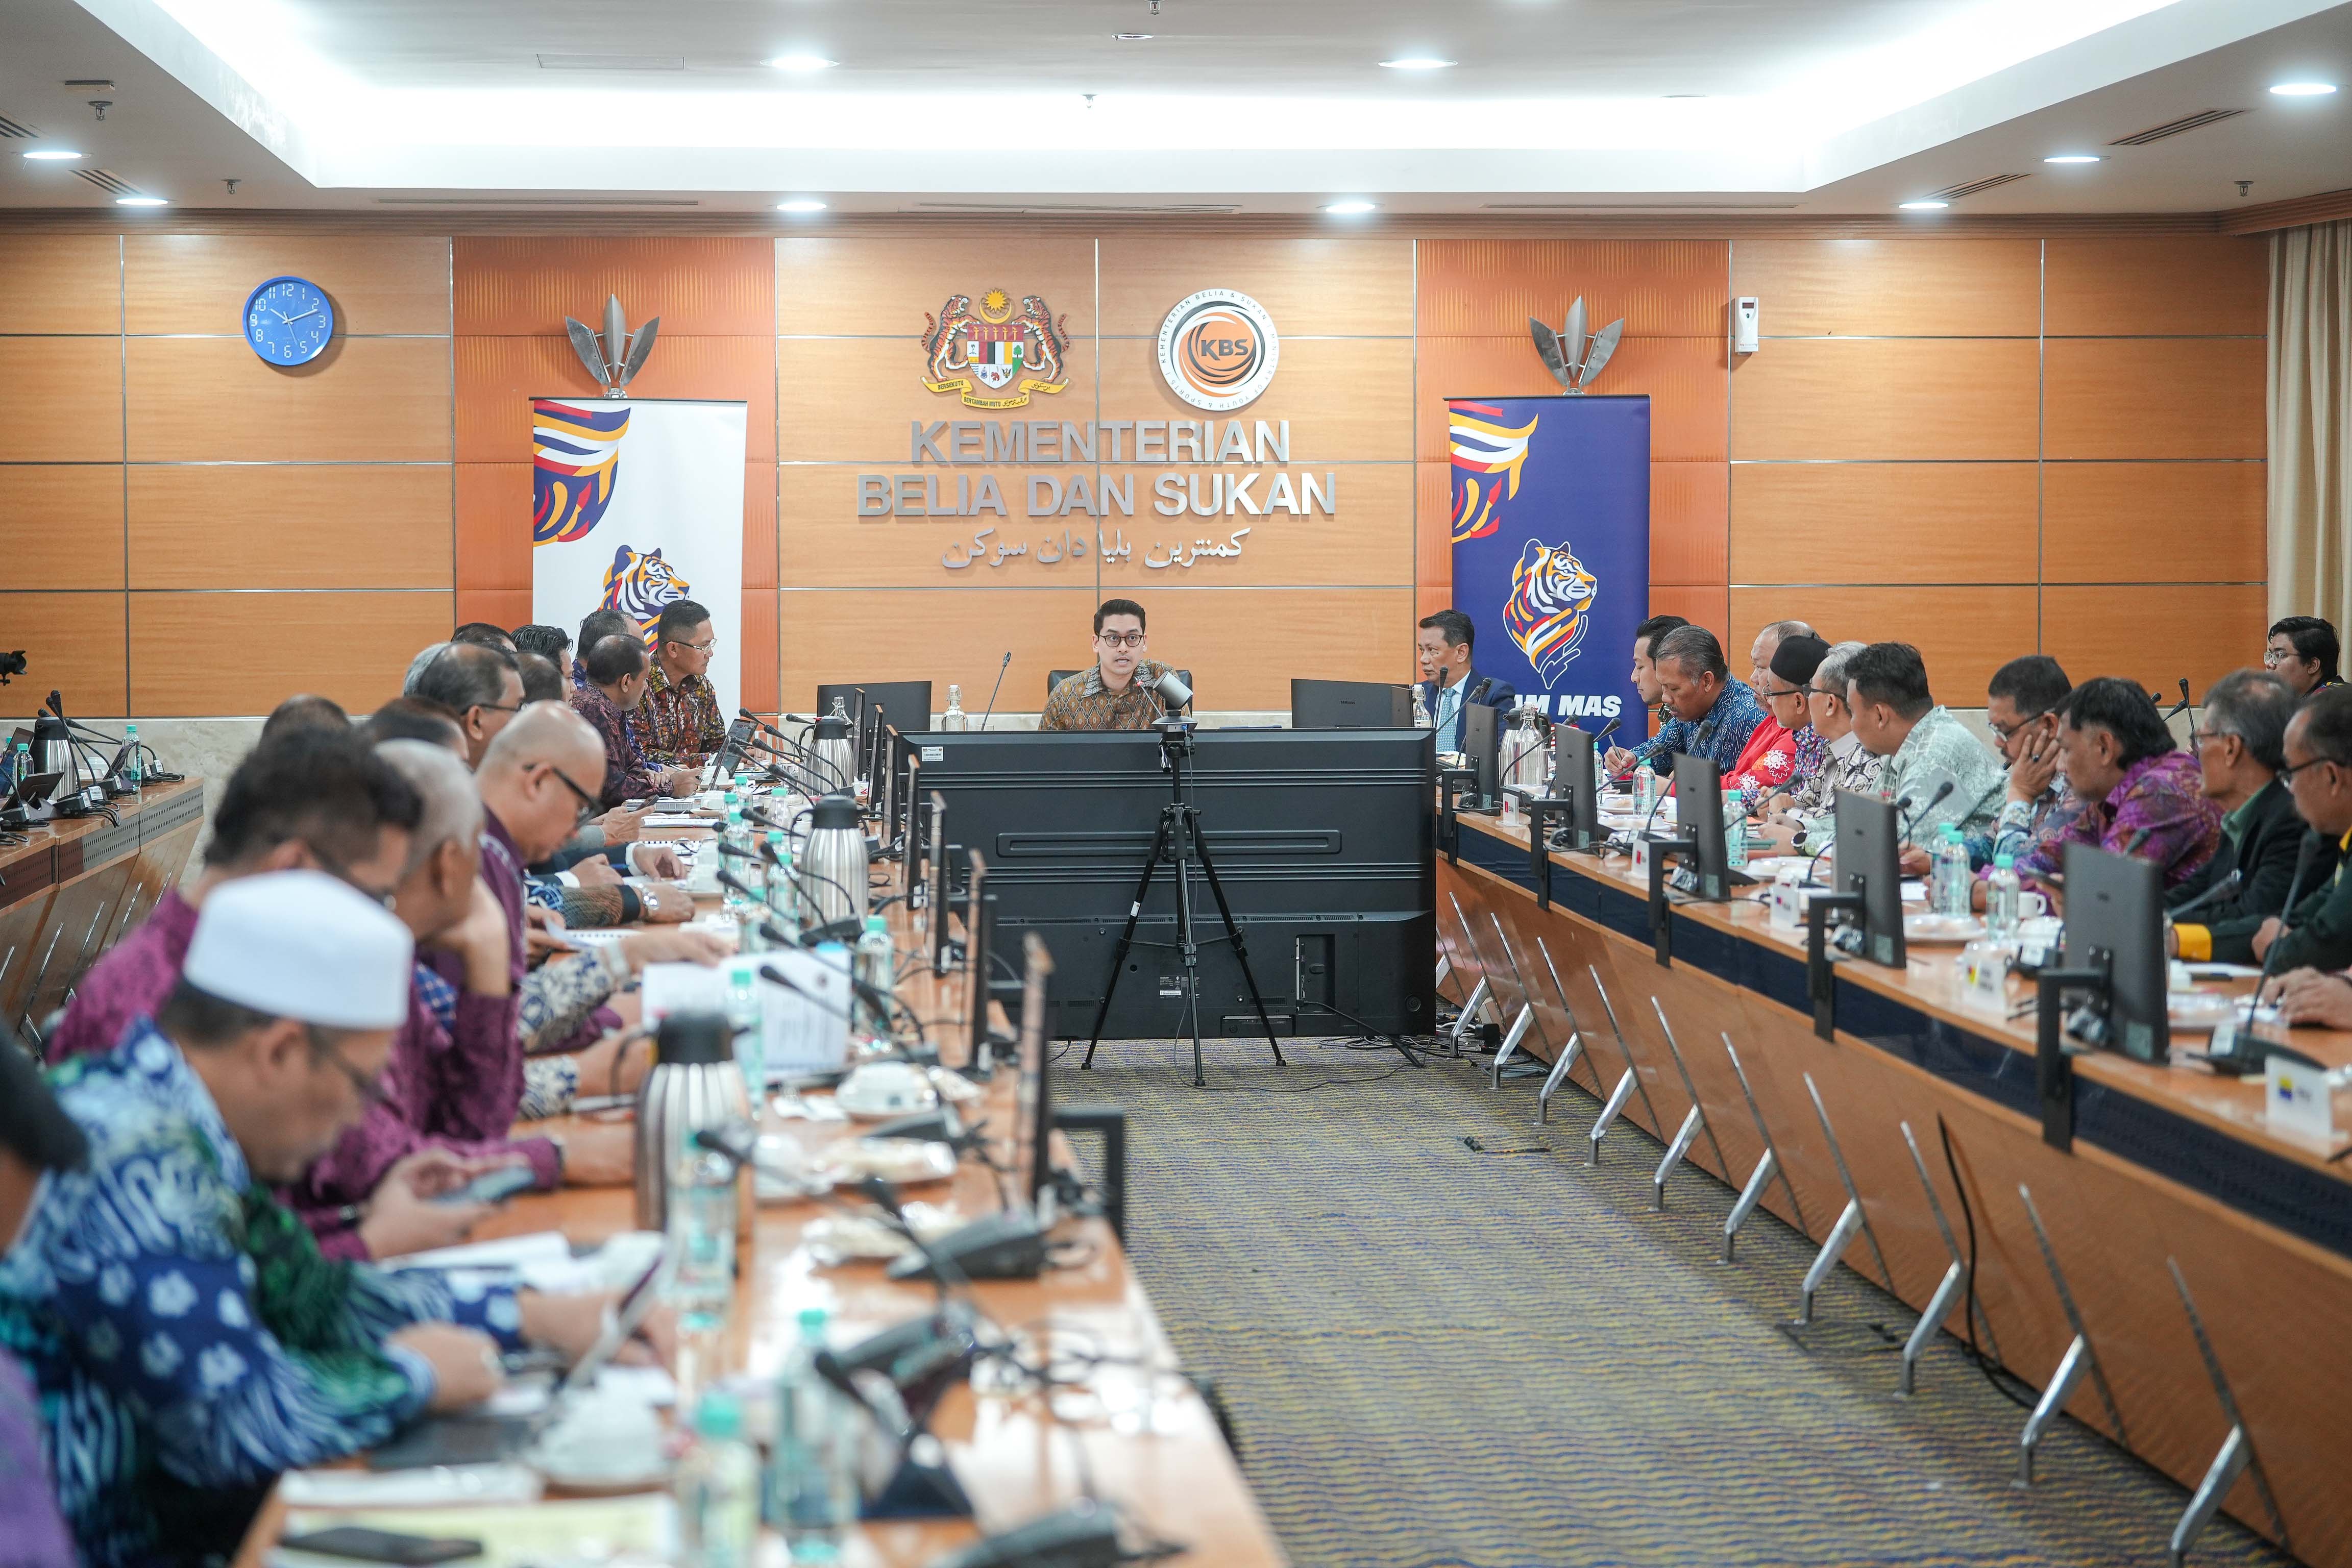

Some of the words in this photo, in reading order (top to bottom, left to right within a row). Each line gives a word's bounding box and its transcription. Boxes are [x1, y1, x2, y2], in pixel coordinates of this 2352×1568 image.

[269, 286, 276, 299] 11
[282, 284, 294, 297] 12
[302, 287, 305, 300] 1
[255, 298, 266, 311] 10
[312, 298, 320, 310] 2
[250, 313, 258, 327] 9
[318, 314, 326, 328] 3
[1160, 300, 1190, 363] KEMENTERIAN
[1195, 290, 1224, 300] BELIA
[1241, 296, 1267, 321] SUKAN
[255, 329, 263, 342] 8
[311, 331, 319, 344] 4
[267, 341, 275, 354] 7
[284, 345, 292, 358] 6
[300, 340, 307, 354] 5
[1200, 339, 1248, 360] KBS
[938, 380, 964, 390] BERSEKUTU
[1170, 379, 1202, 406] SPORTS
[963, 397, 988, 407] BERTAMBAH
[1219, 396, 1250, 409] YOUTH
[911, 420, 1290, 462] KEMENTERIAN
[857, 474, 1007, 516] BELIA
[1027, 473, 1134, 516] DAN
[1154, 472, 1335, 516] SUKAN
[1037, 528, 1087, 563] دان
[1097, 528, 1131, 563] بليا
[1558, 695, 1622, 718] MAS
